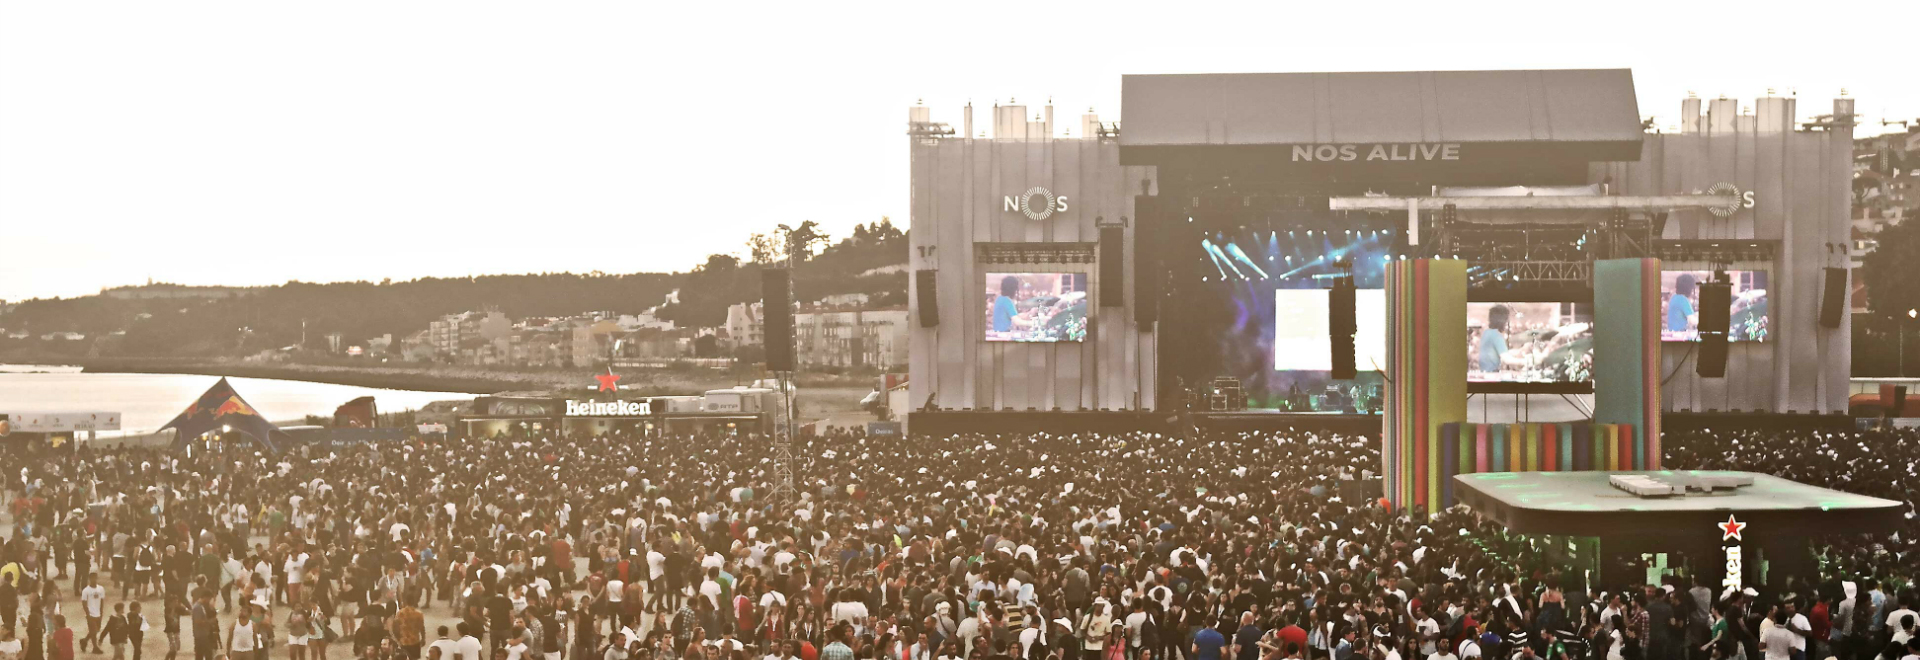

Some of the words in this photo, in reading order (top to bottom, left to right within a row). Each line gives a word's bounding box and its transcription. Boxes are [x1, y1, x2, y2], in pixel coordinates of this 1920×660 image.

[1292, 144, 1357, 161] NOS
[1366, 144, 1461, 161] ALIVE
[1004, 186, 1068, 221] NOS
[565, 398, 652, 416] Heineken
